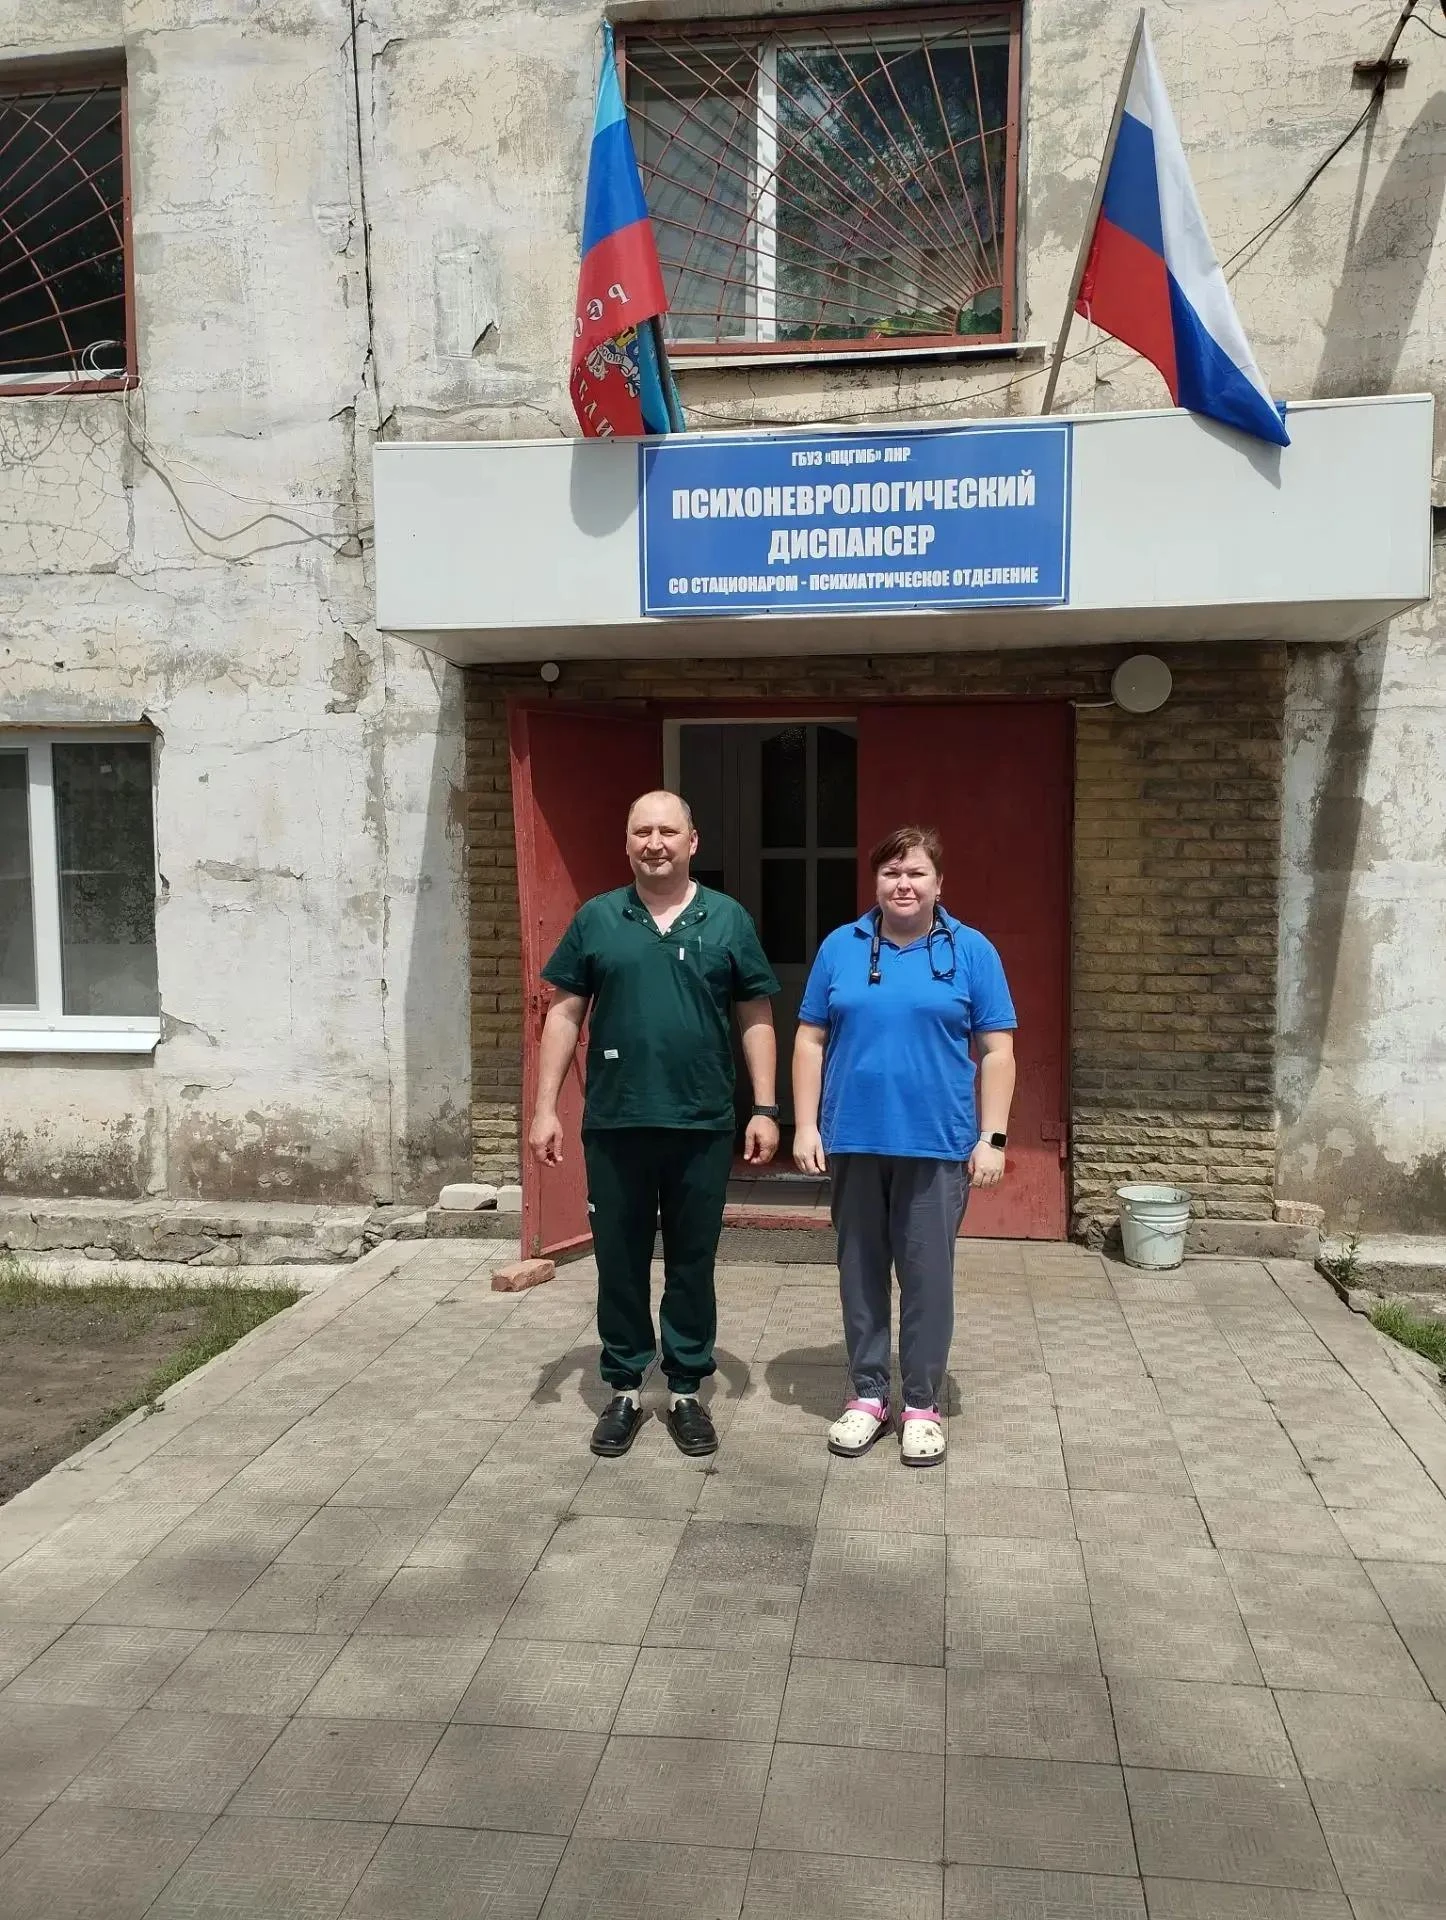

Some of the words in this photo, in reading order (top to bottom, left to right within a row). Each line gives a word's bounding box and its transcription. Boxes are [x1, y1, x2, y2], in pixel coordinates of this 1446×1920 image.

[791, 450, 823, 467] ГБУЗ
[884, 447, 911, 463] ЛНР
[672, 469, 1036, 520] ПСИХОНЕВРОЛОГИЧЕСКИЙ
[767, 524, 935, 565] ДИСПАНСЕР
[668, 577, 688, 595] СО
[691, 575, 799, 596] СТАЦИОНАРОМ
[809, 570, 950, 592] ПСИХИАТРИЧЕСКОЕ
[952, 566, 1039, 588] ОТДЕЛЕНИЕ
